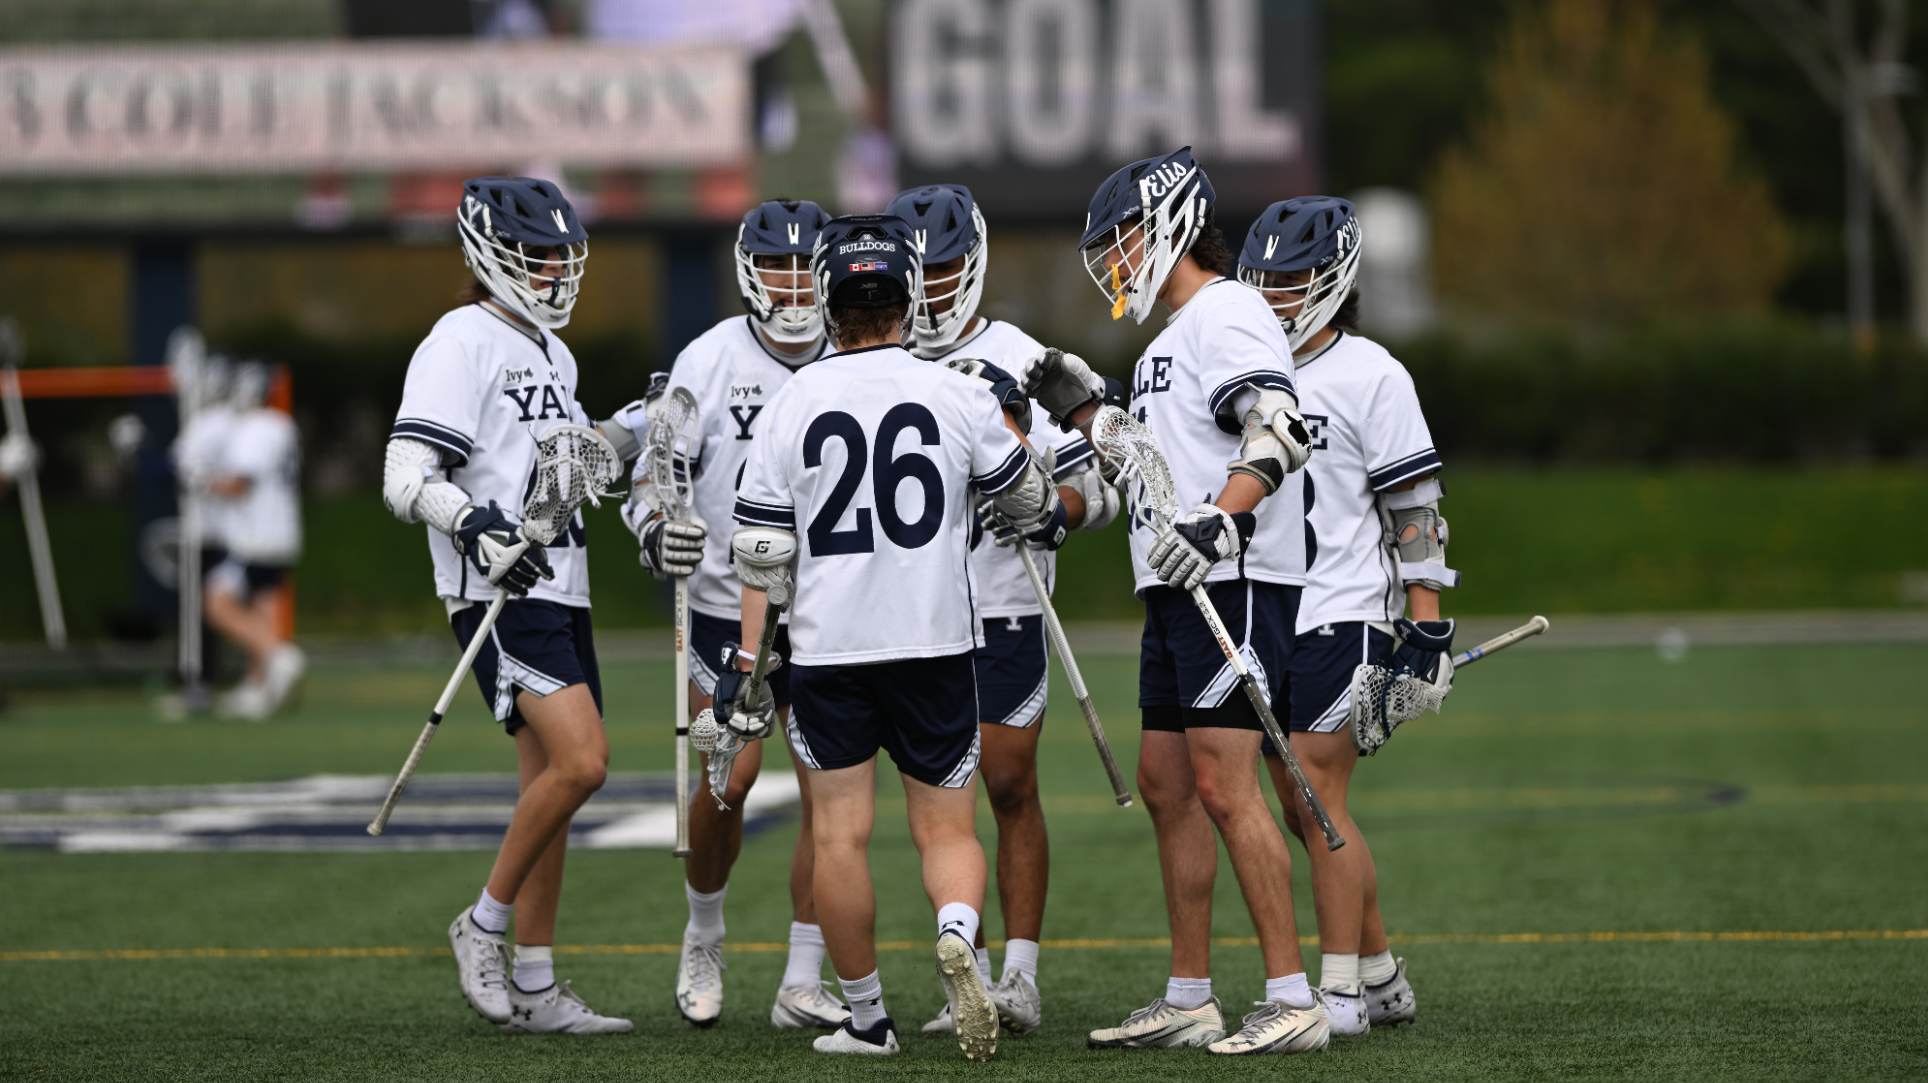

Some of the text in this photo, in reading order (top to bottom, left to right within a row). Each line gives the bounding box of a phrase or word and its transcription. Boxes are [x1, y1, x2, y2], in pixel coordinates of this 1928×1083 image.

[893, 0, 1301, 166] GOAL
[1145, 161, 1187, 197] Elis
[839, 241, 896, 254] BULLDOGS
[505, 369, 523, 383] Ivy
[731, 385, 750, 399] Ivy
[504, 384, 573, 422] YA
[803, 402, 945, 557] 26
